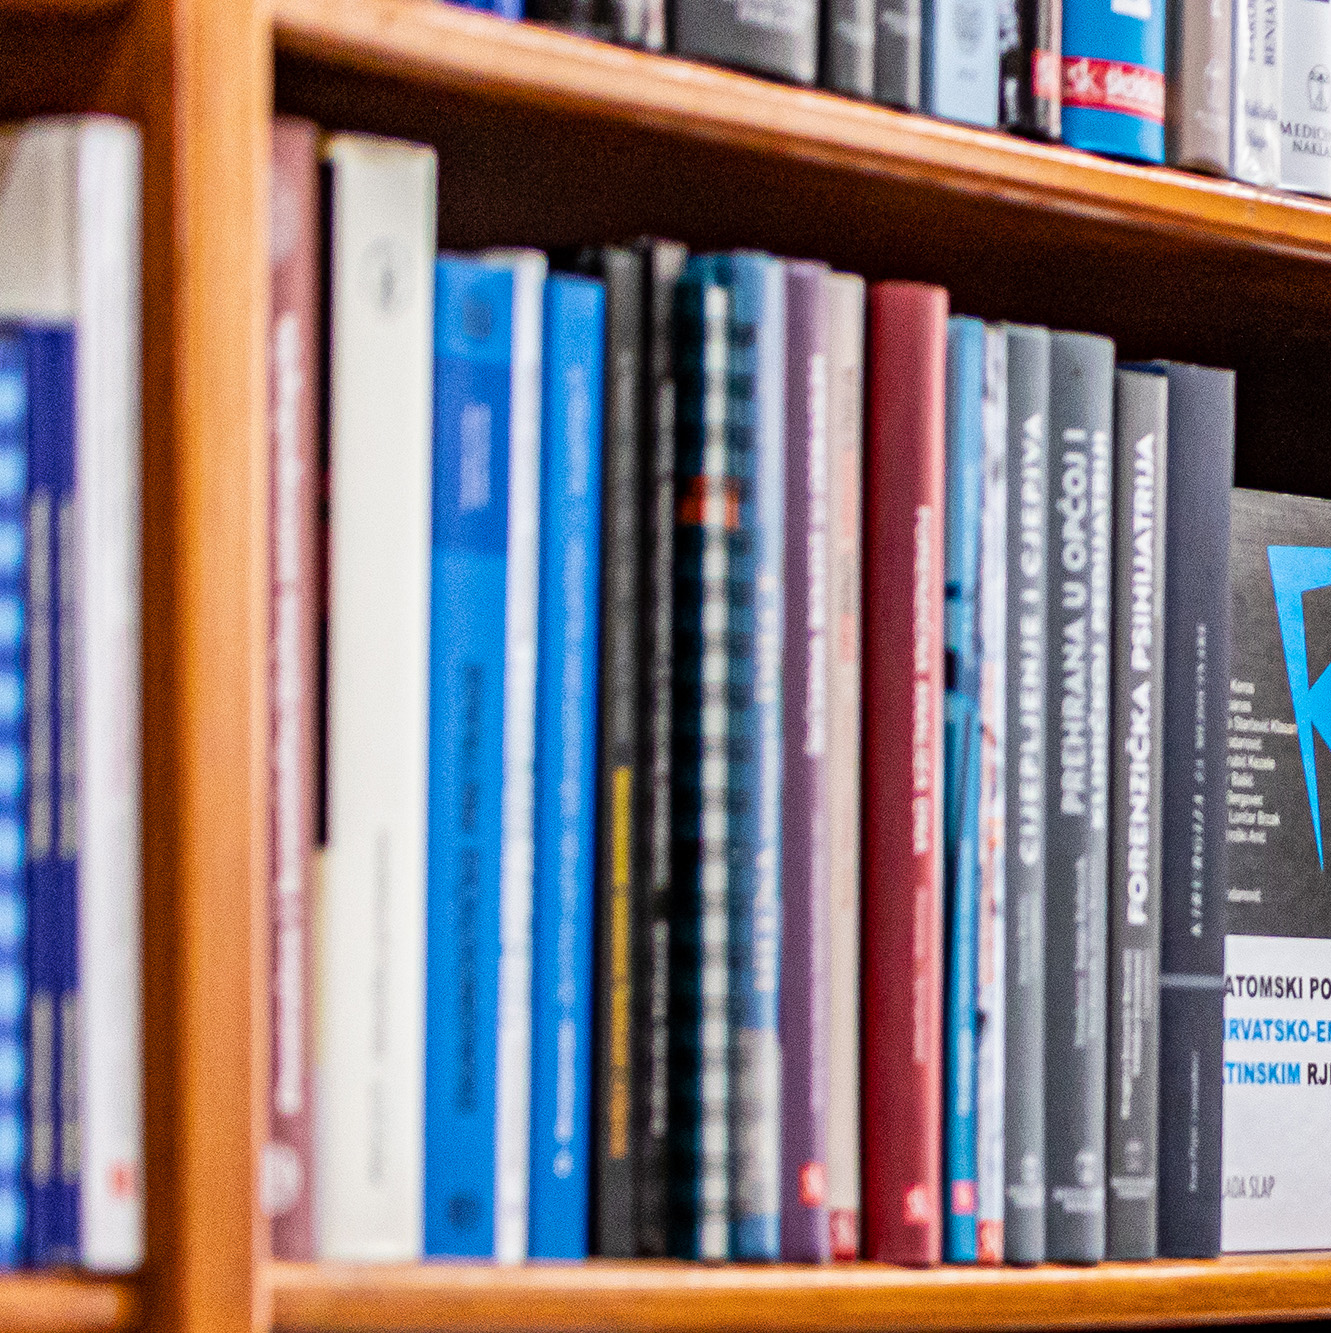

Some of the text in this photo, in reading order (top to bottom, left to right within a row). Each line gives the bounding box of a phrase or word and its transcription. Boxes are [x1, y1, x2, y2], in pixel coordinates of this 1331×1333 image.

[1061, 583, 1086, 607] U
[1131, 433, 1155, 672] PSIHIJATRIJA
[1126, 680, 1151, 926] FORENZIČKA
[1223, 1060, 1301, 1086] TINSKIM
